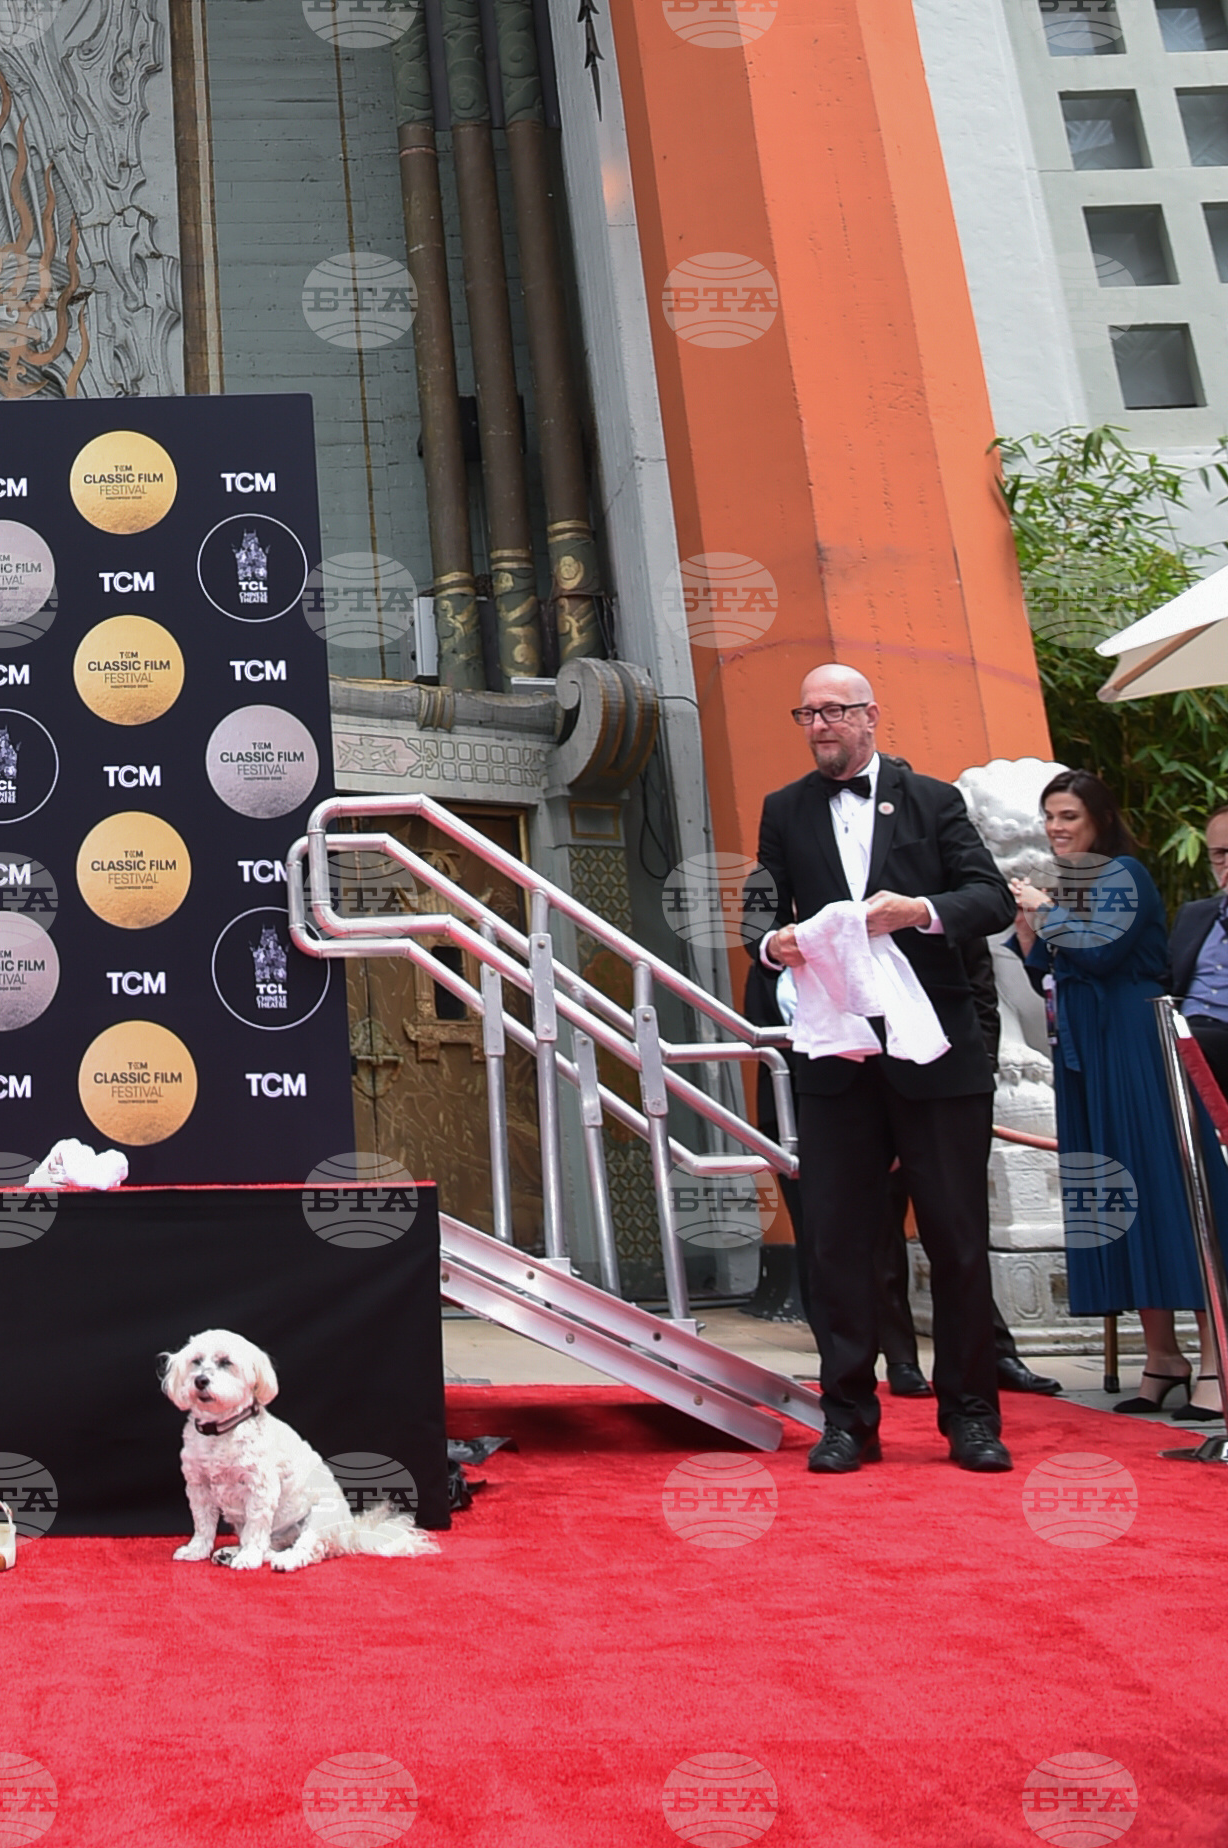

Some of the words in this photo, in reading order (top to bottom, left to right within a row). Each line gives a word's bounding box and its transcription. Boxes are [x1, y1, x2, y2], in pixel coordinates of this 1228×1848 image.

[84, 474, 134, 484] CLASSIC
[138, 473, 164, 483] FILM
[221, 473, 276, 493] TCM
[100, 484, 147, 495] FESTIVAL
[16, 563, 41, 573] FILM
[99, 572, 154, 592] TCM
[239, 581, 267, 590] TCL
[88, 660, 140, 671] CLASSIC
[144, 660, 170, 670] FILM
[230, 660, 286, 681] TCM
[104, 672, 153, 683] FESTIVAL
[220, 751, 274, 762] CLASSIC
[278, 751, 304, 761] FILM
[237, 764, 287, 775] FESTIVAL
[104, 765, 161, 786] TCM
[91, 860, 146, 871] CLASSIC
[150, 860, 177, 870] FILM
[108, 873, 158, 884] FESTIVAL
[17, 960, 45, 971] FILM
[106, 972, 165, 994] TCM
[256, 984, 287, 994] TCL
[94, 1072, 150, 1084] CLASSIC
[154, 1072, 182, 1083] FILM
[246, 1073, 306, 1097] TCM
[111, 1086, 163, 1098] FESTIVAL
